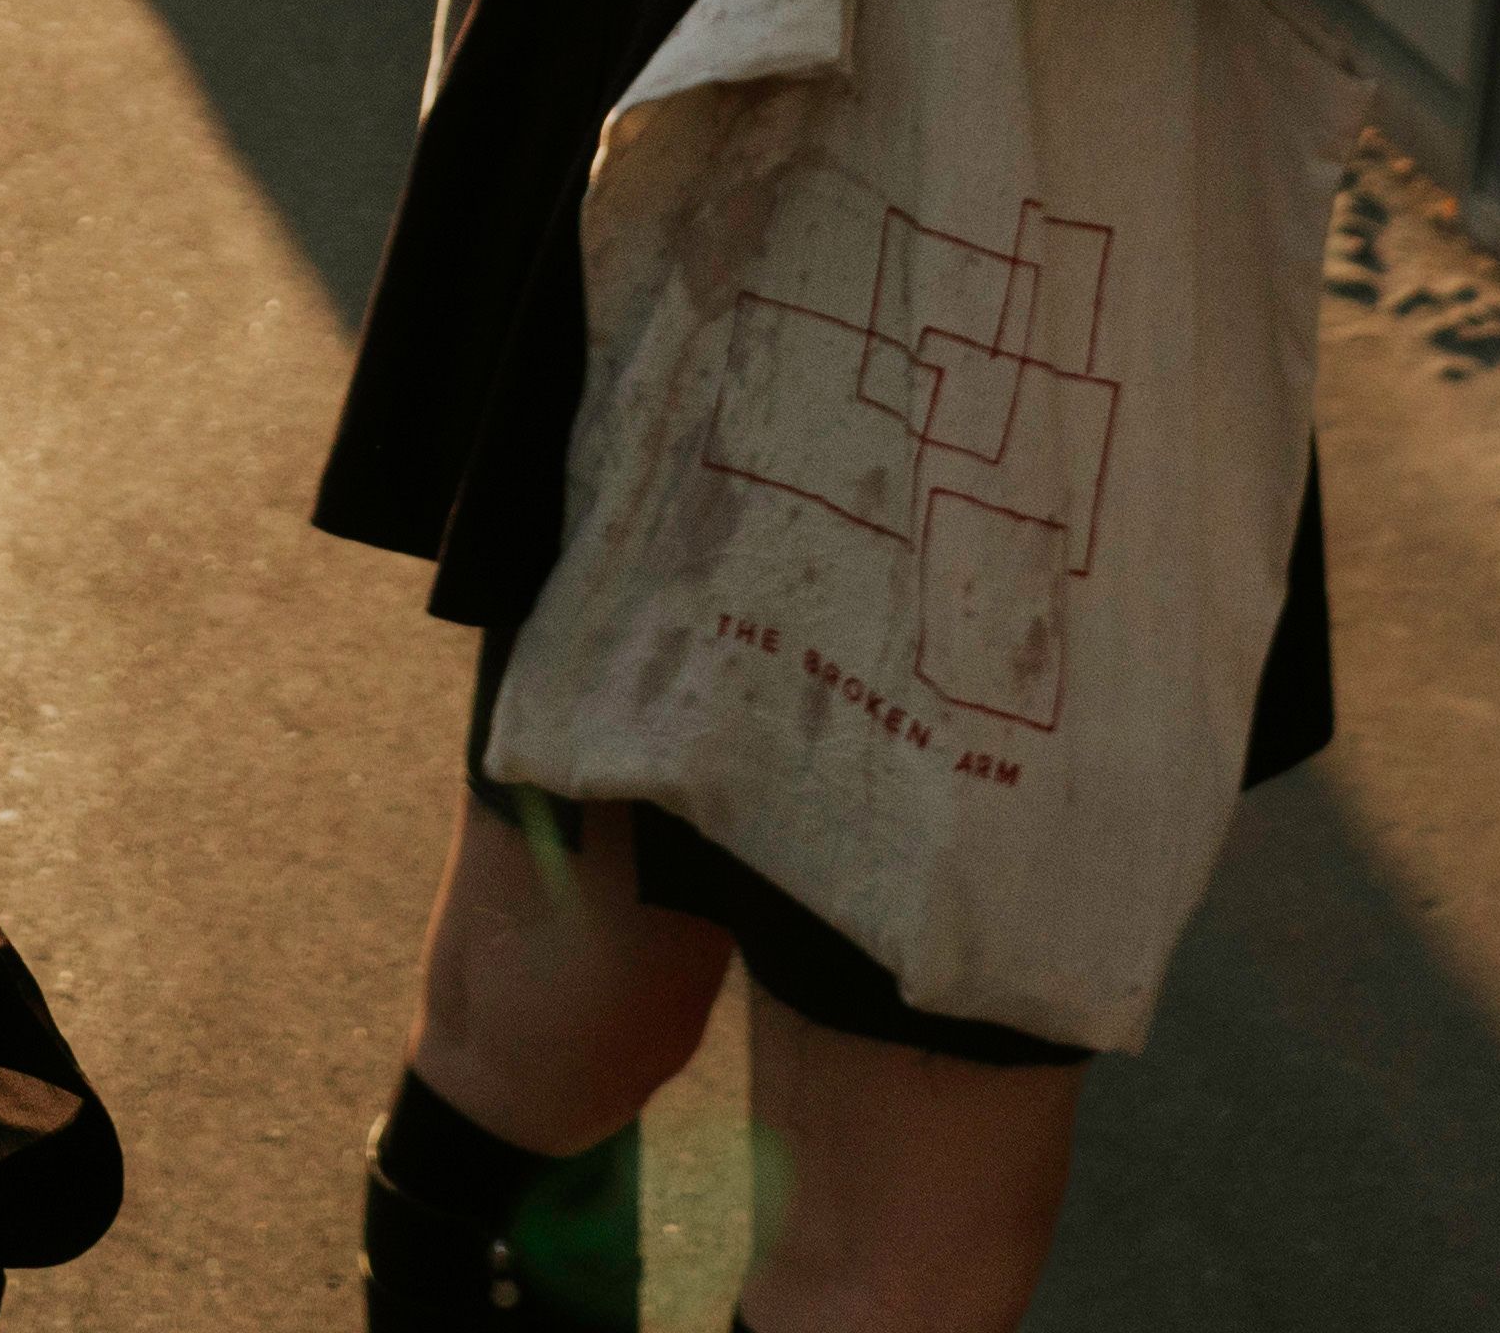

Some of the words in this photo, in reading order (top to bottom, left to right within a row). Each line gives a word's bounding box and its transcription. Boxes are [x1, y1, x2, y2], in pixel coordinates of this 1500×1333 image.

[717, 612, 780, 655] THE
[803, 648, 932, 750] BROKEN
[955, 750, 1022, 787] ARM
